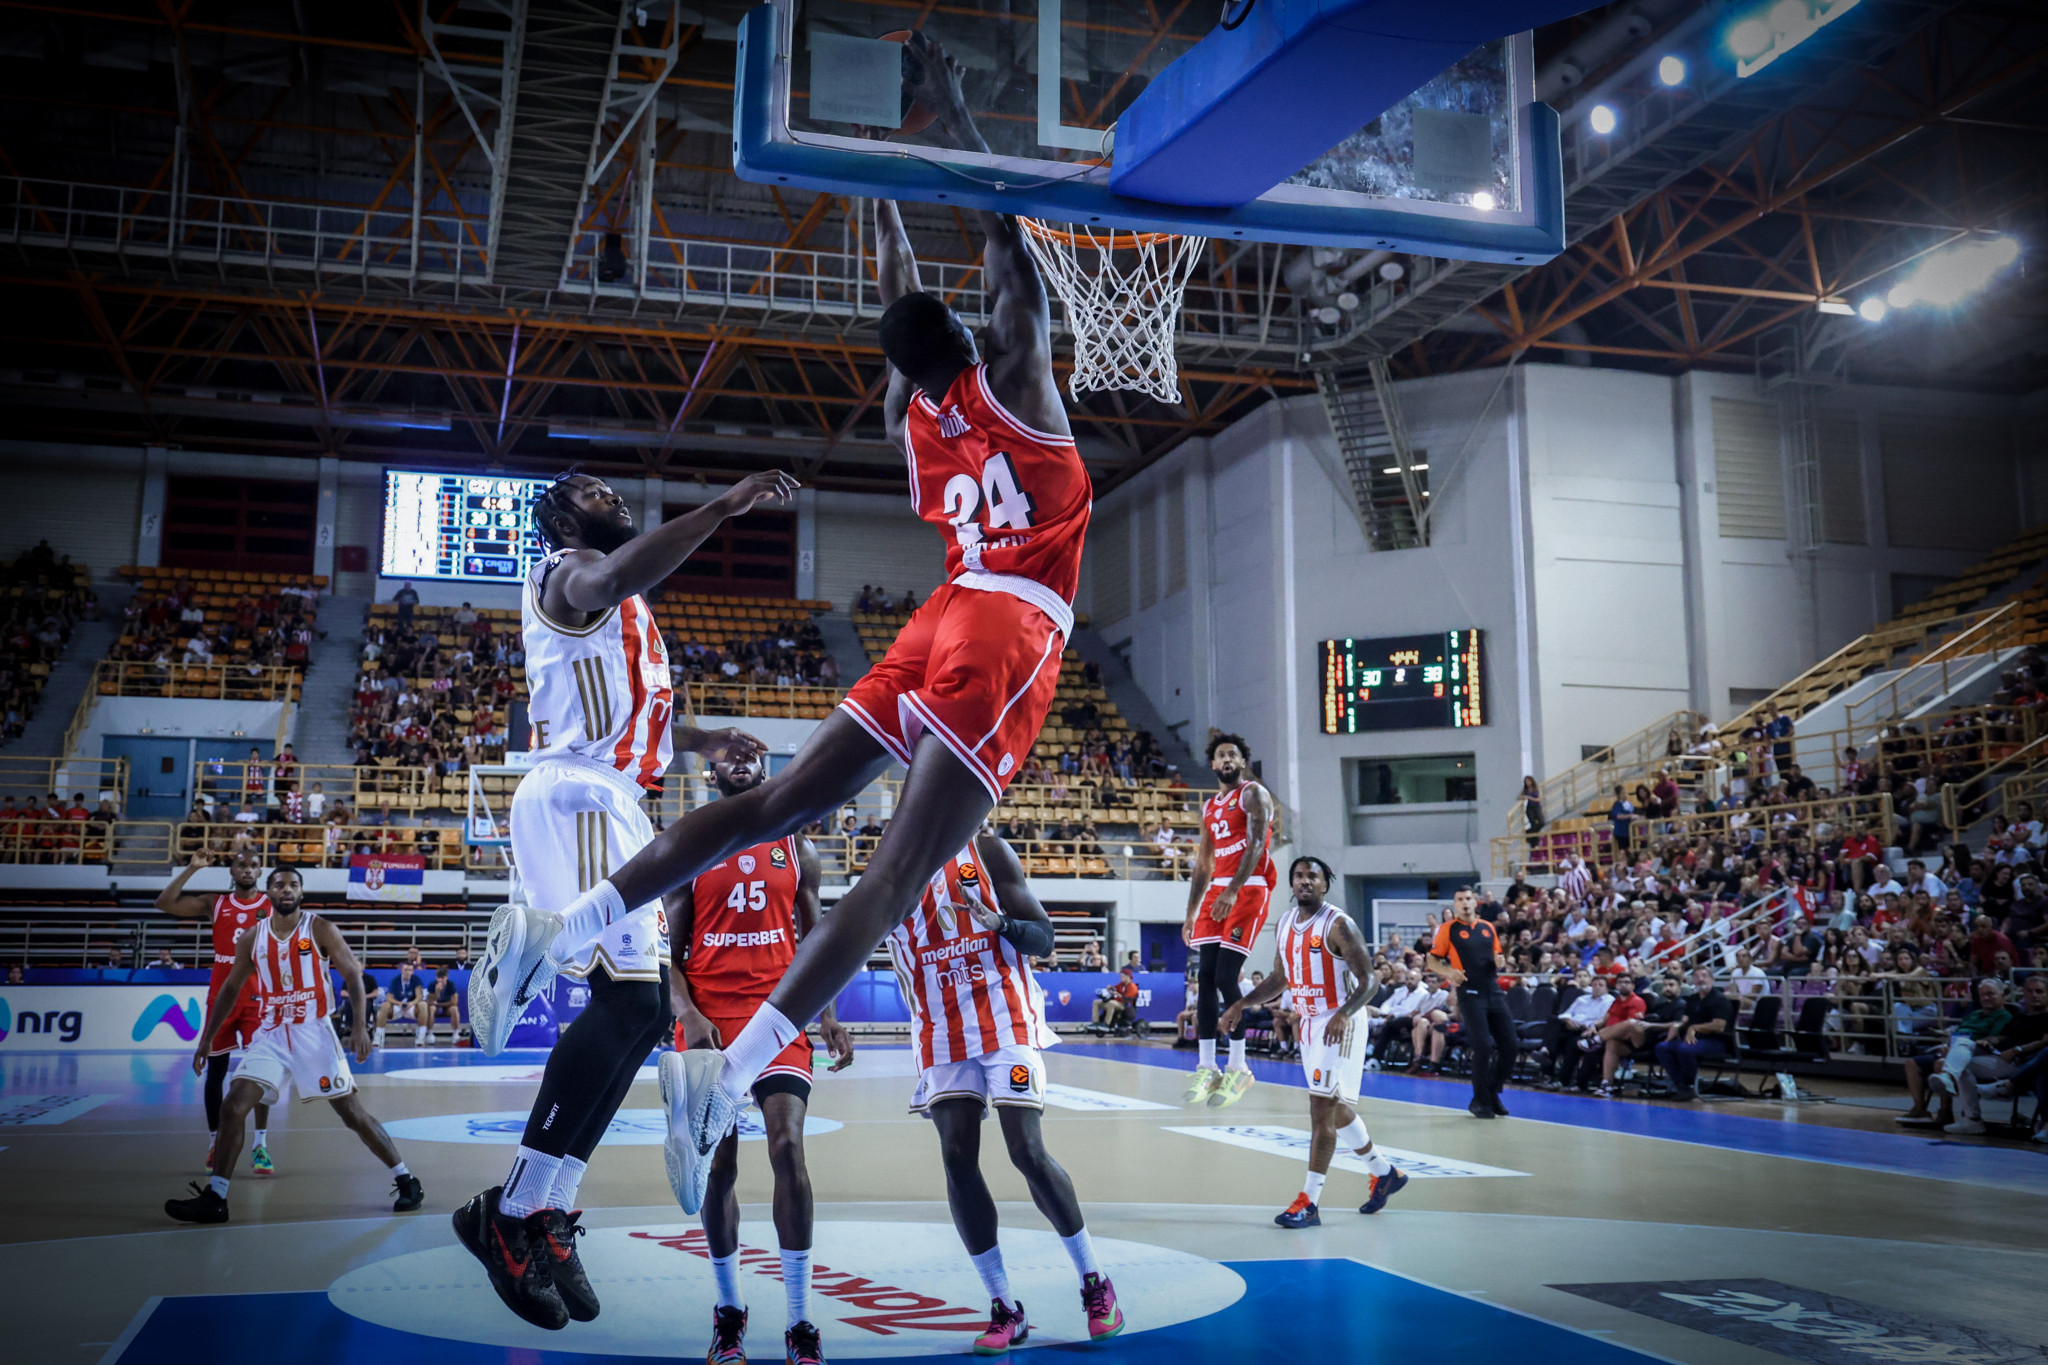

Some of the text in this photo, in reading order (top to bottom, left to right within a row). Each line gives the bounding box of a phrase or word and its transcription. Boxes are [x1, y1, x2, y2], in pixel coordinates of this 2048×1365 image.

[943, 451, 1037, 545] 24
[466, 527, 476, 539] 4
[1362, 666, 1443, 686] 30 2 38
[1359, 683, 1444, 701] 4 3
[1210, 819, 1232, 840] 22
[727, 880, 767, 913] 45
[703, 928, 787, 948] SUPERBET
[921, 937, 989, 964] meridian
[281, 970, 294, 987] 6
[936, 961, 985, 989] mts
[267, 990, 315, 1005] meridian
[1291, 985, 1324, 997] eridian
[279, 1003, 306, 1019] mts
[16, 1011, 83, 1043] nrg
[333, 1074, 346, 1090] 6
[1324, 1069, 1332, 1088] 1
[542, 1102, 560, 1131] TECHFIT
